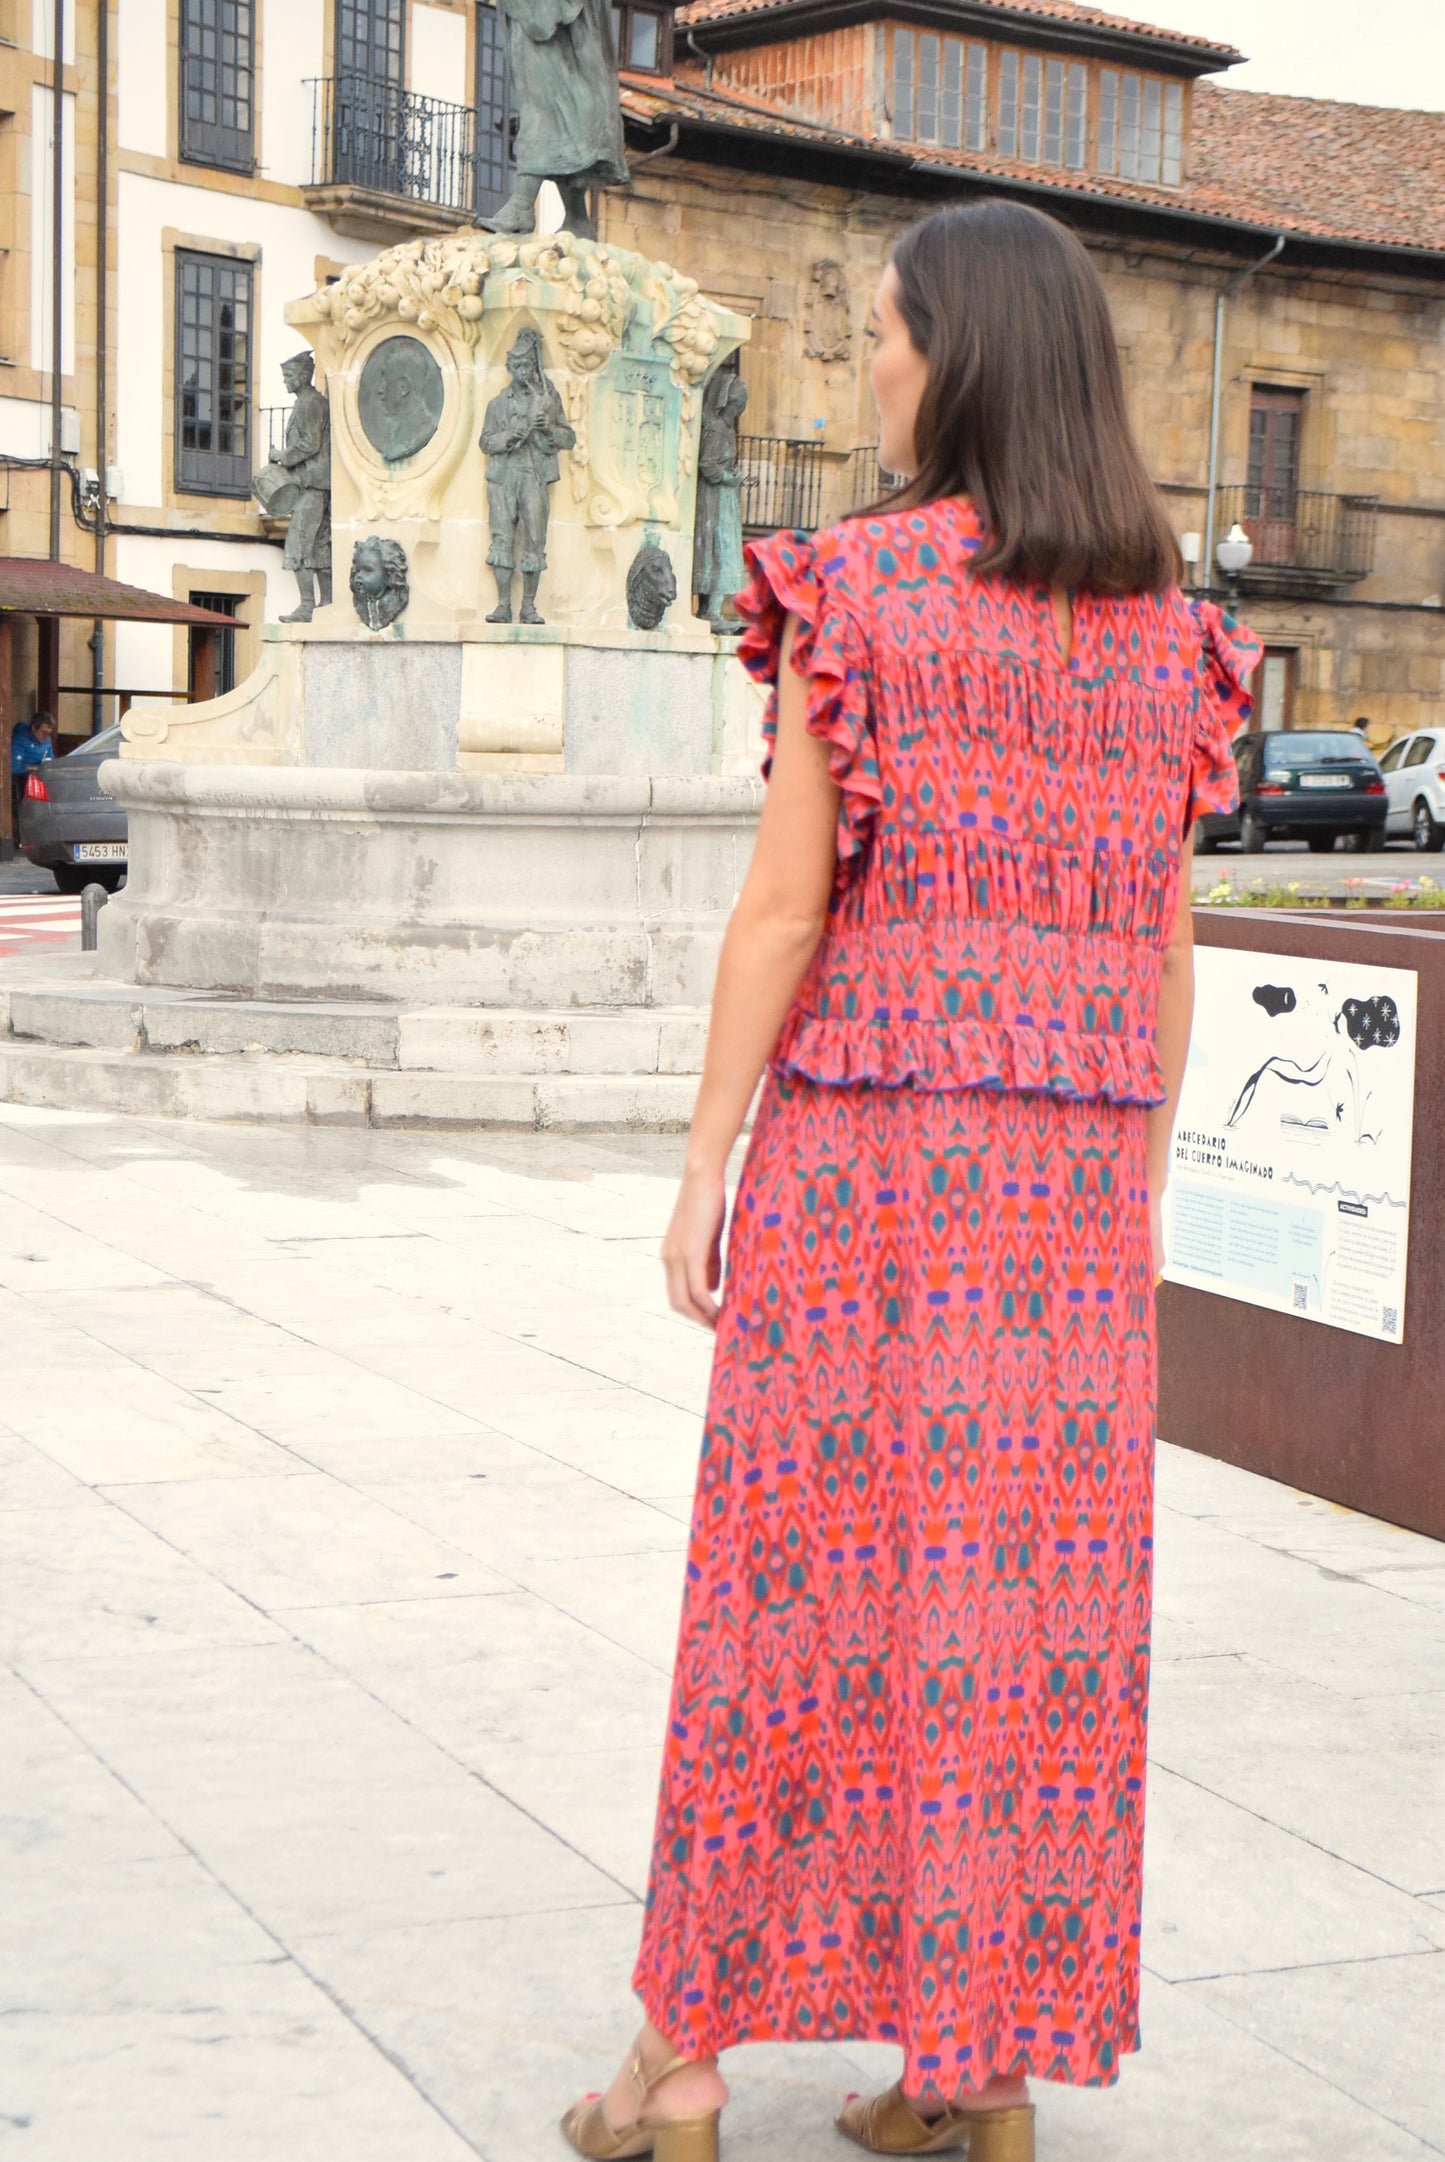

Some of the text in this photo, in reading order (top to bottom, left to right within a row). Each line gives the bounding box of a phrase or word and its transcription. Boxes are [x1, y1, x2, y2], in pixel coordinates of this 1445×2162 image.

[82, 845, 108, 858] 5453
[1177, 1129, 1226, 1151] ABECEDARIO
[1176, 1146, 1188, 1160] DEL
[1192, 1150, 1222, 1168] CUERPO
[1226, 1156, 1273, 1179] IMAGINADO
